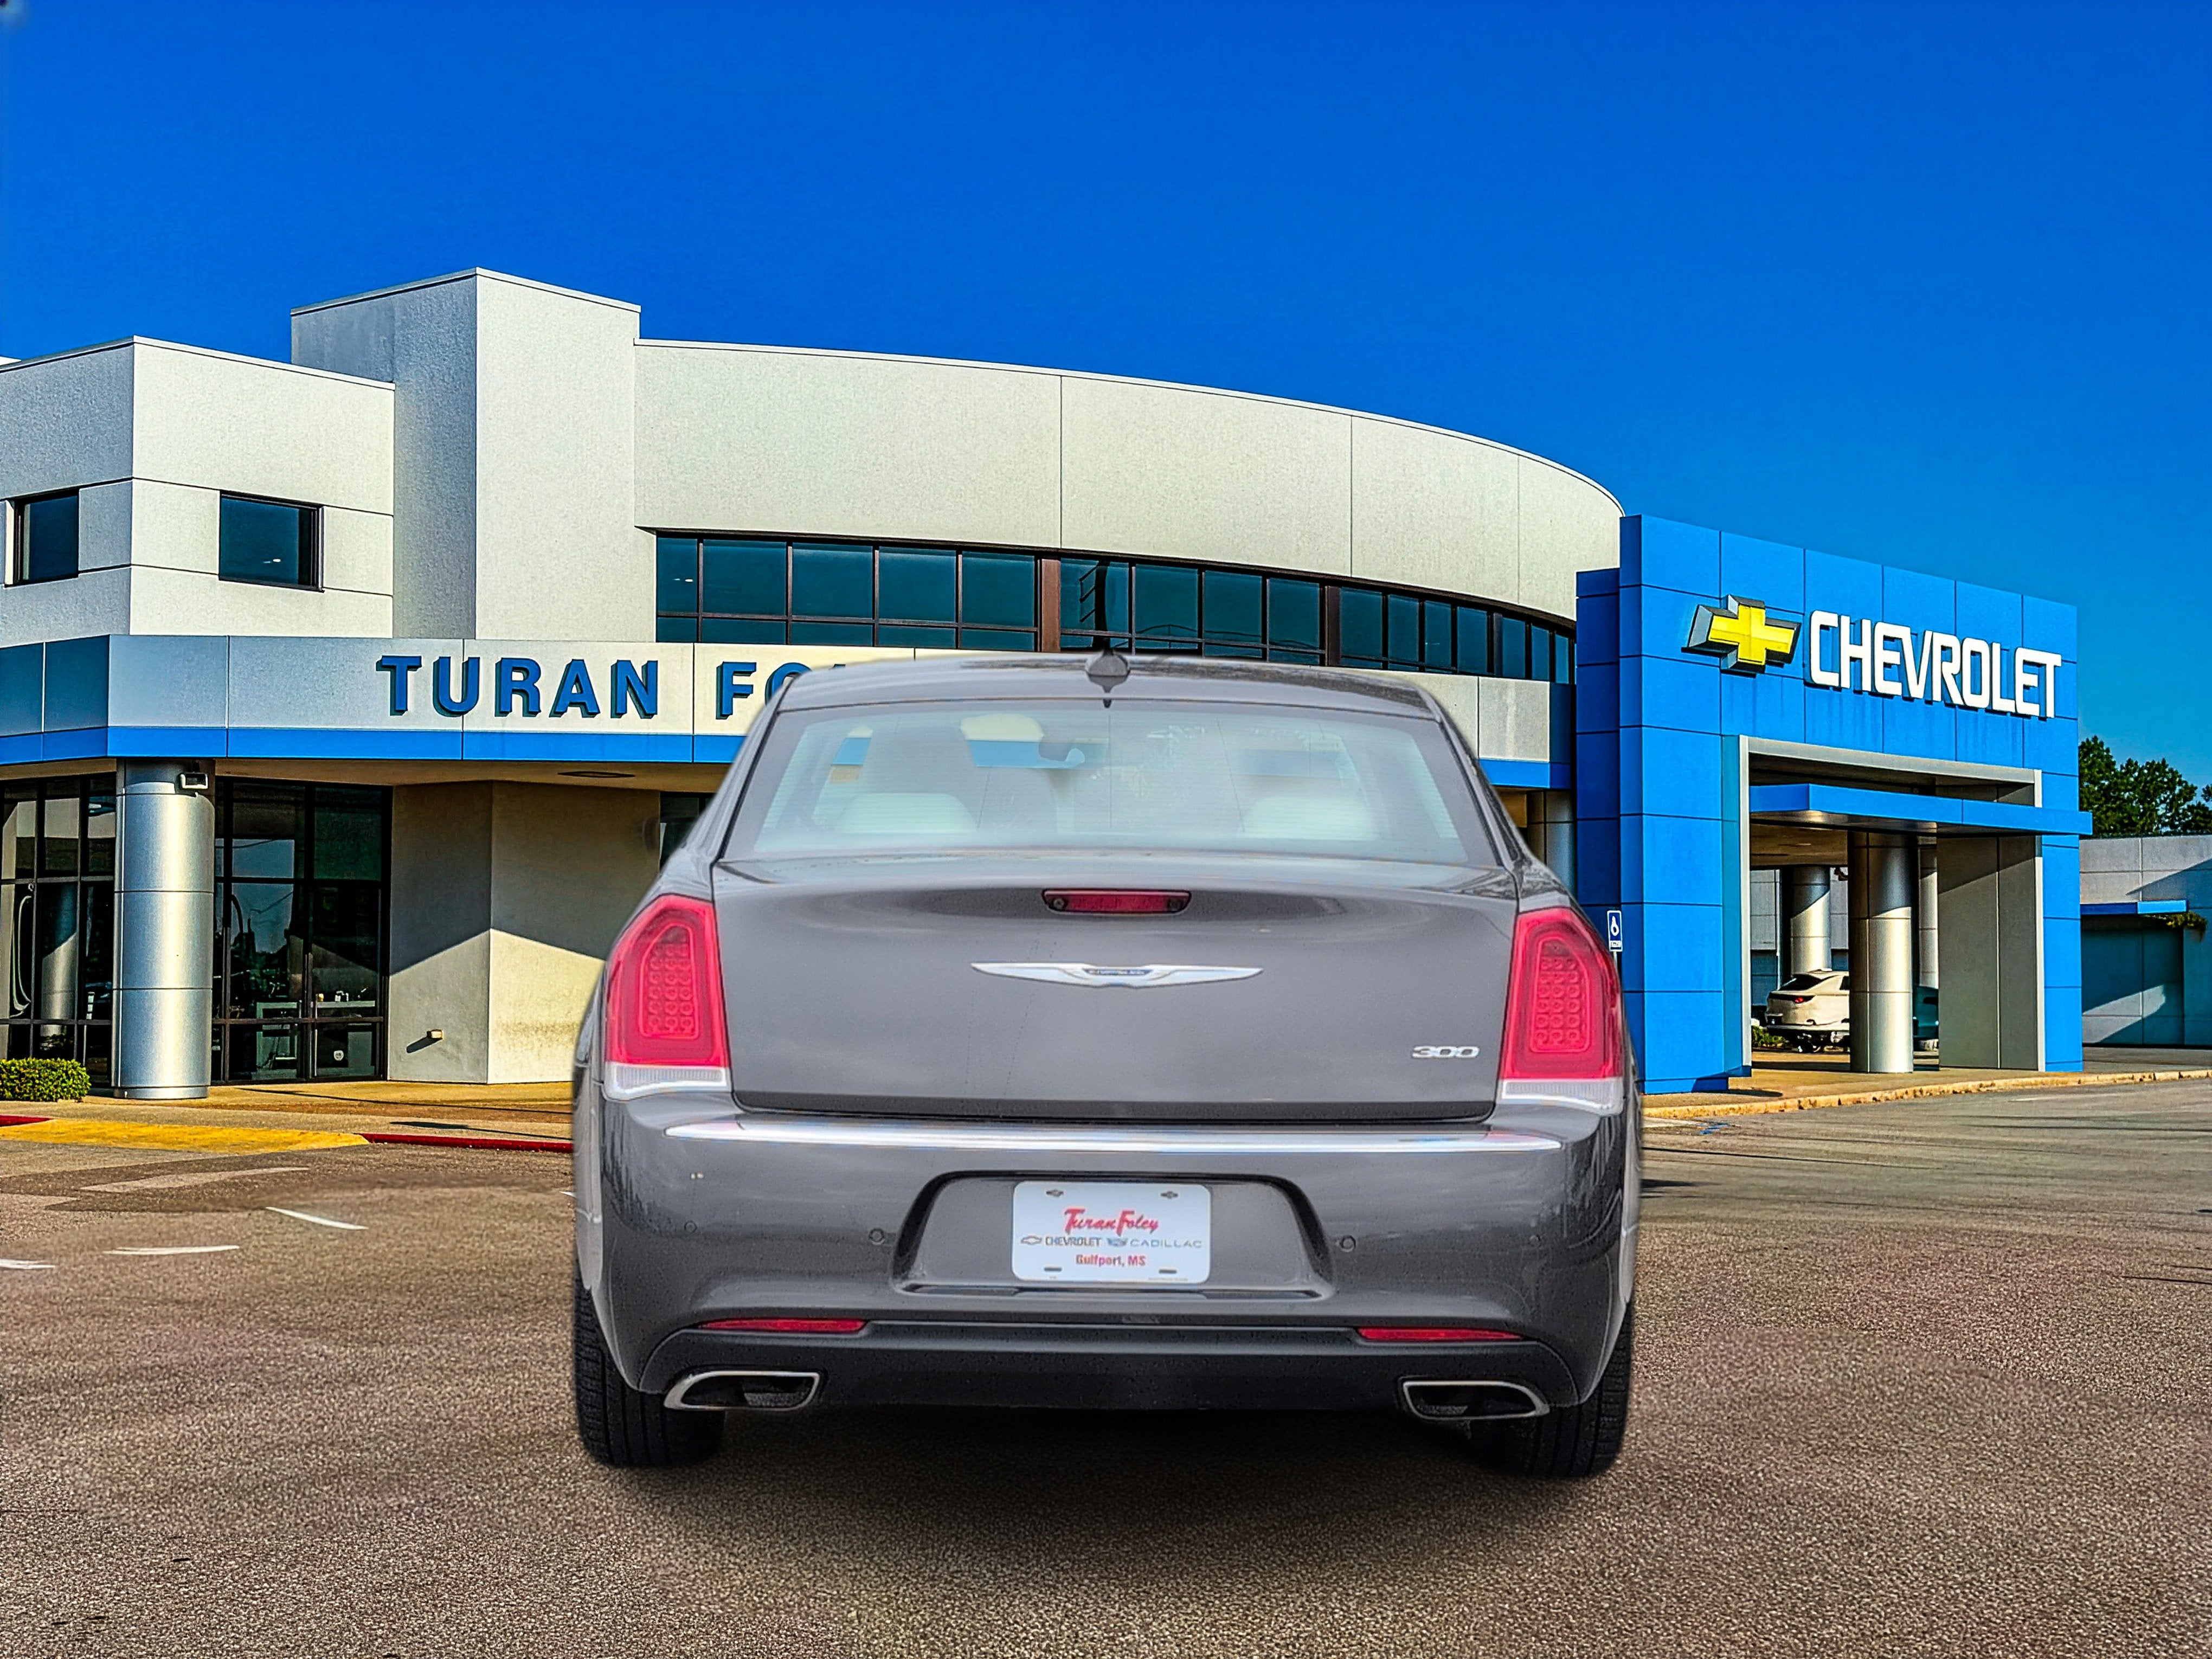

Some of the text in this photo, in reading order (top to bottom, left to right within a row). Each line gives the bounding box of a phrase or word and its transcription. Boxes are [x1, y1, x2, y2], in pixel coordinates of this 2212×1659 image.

[1809, 610, 2062, 719] CHEVROLET
[376, 655, 659, 718] TURAN
[1412, 1046, 1480, 1058] 300
[1045, 1237, 1202, 1248] CHEVROLET CADILLAC
[1076, 1254, 1146, 1267] Gulfport, MS
